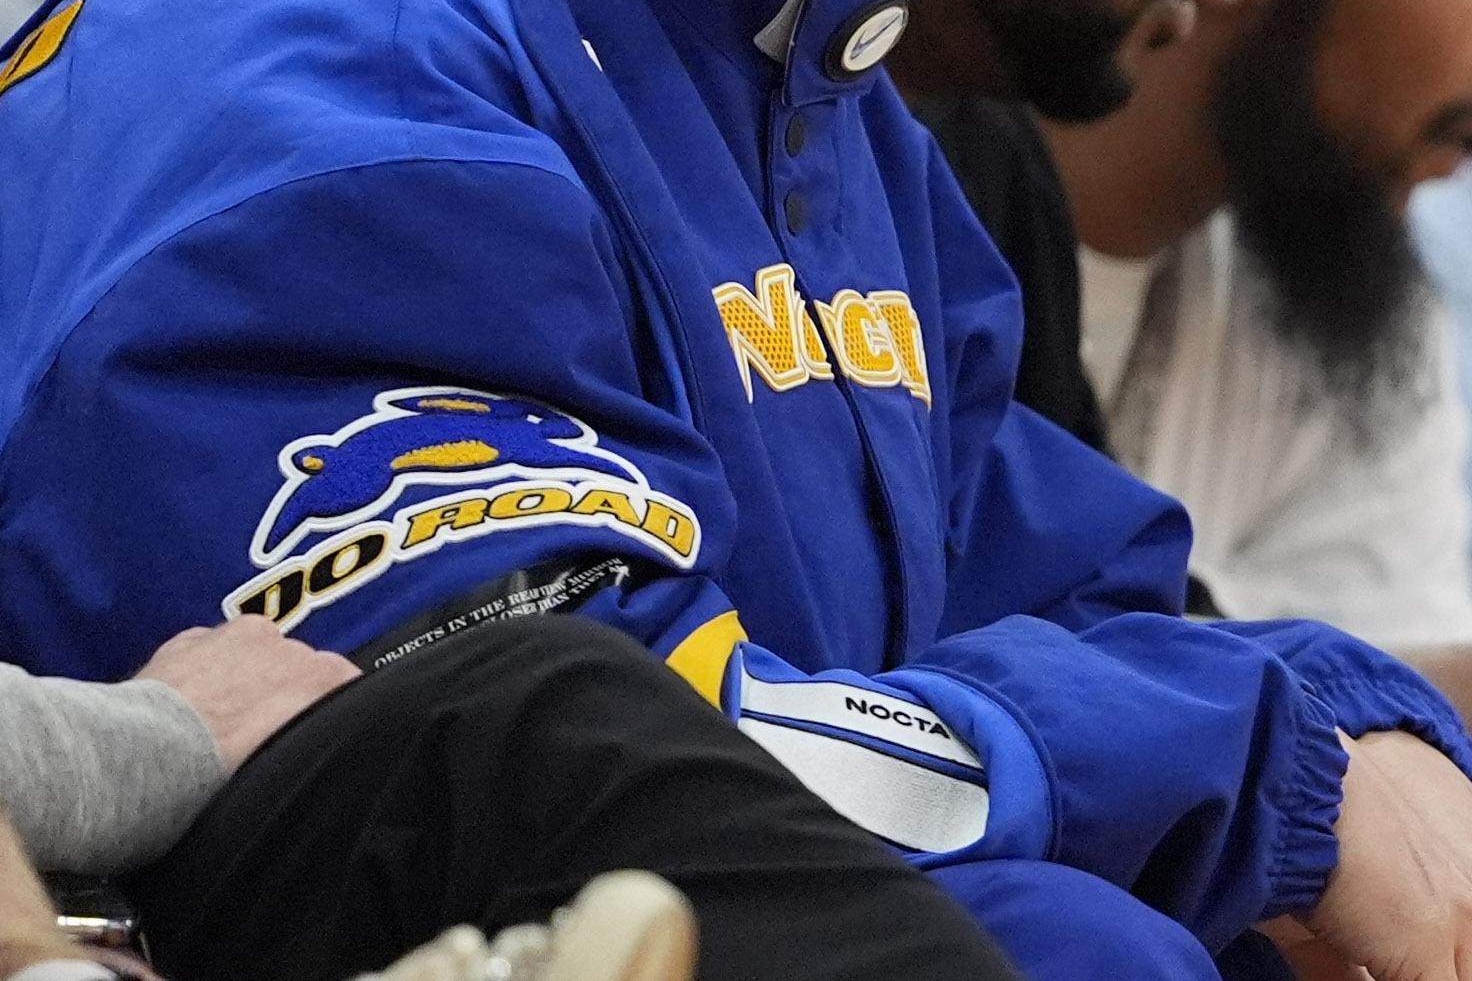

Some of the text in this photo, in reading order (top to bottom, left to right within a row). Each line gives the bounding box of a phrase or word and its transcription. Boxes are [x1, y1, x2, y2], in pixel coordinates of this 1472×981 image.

[238, 487, 698, 624] DO ROAD
[537, 592, 570, 612] THAN
[374, 626, 446, 669] OBJECTS
[447, 616, 468, 632] IN
[469, 598, 506, 621] THE
[844, 696, 951, 739] NOCTA
